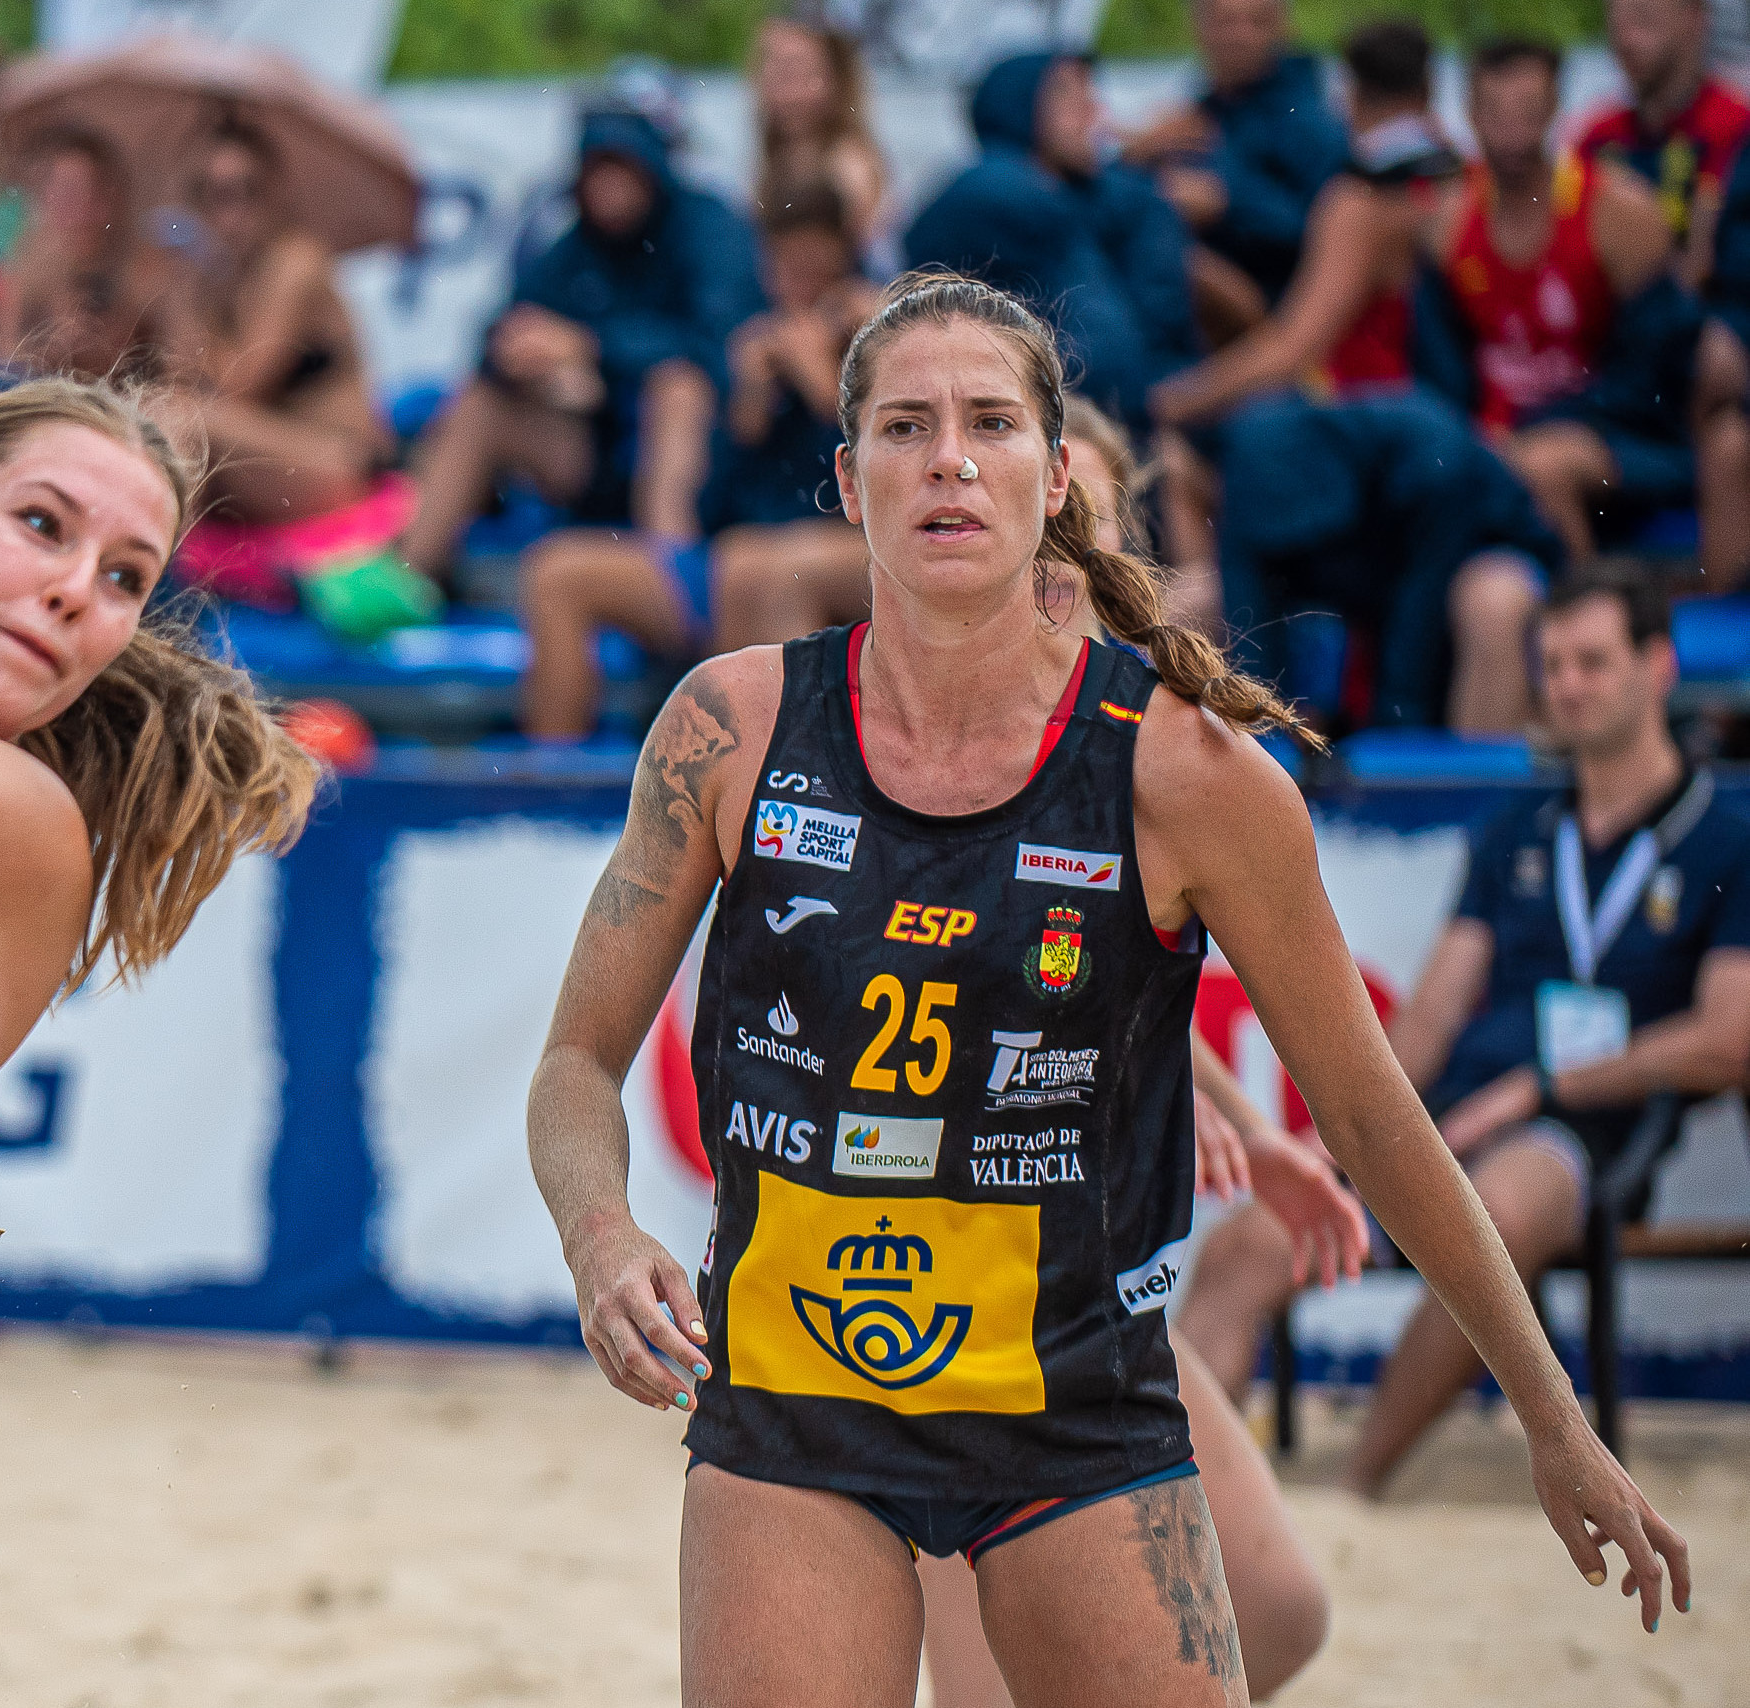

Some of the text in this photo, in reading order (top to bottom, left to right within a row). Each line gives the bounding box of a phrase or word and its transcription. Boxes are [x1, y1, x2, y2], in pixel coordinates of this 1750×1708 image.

[799, 831, 846, 851] SPORT
[802, 818, 857, 840] MELILLA
[796, 844, 850, 864] CAPITAL
[1021, 853, 1088, 874] IBERIA
[884, 900, 978, 947] ESP
[850, 974, 958, 1096] 25
[737, 1026, 825, 1076] Santander
[725, 1100, 817, 1164] AVIS
[972, 1127, 1082, 1152] DIPUTACIÓ DE
[850, 1152, 930, 1168] IBERDROLA
[970, 1152, 1086, 1187] VALÈNCIA
